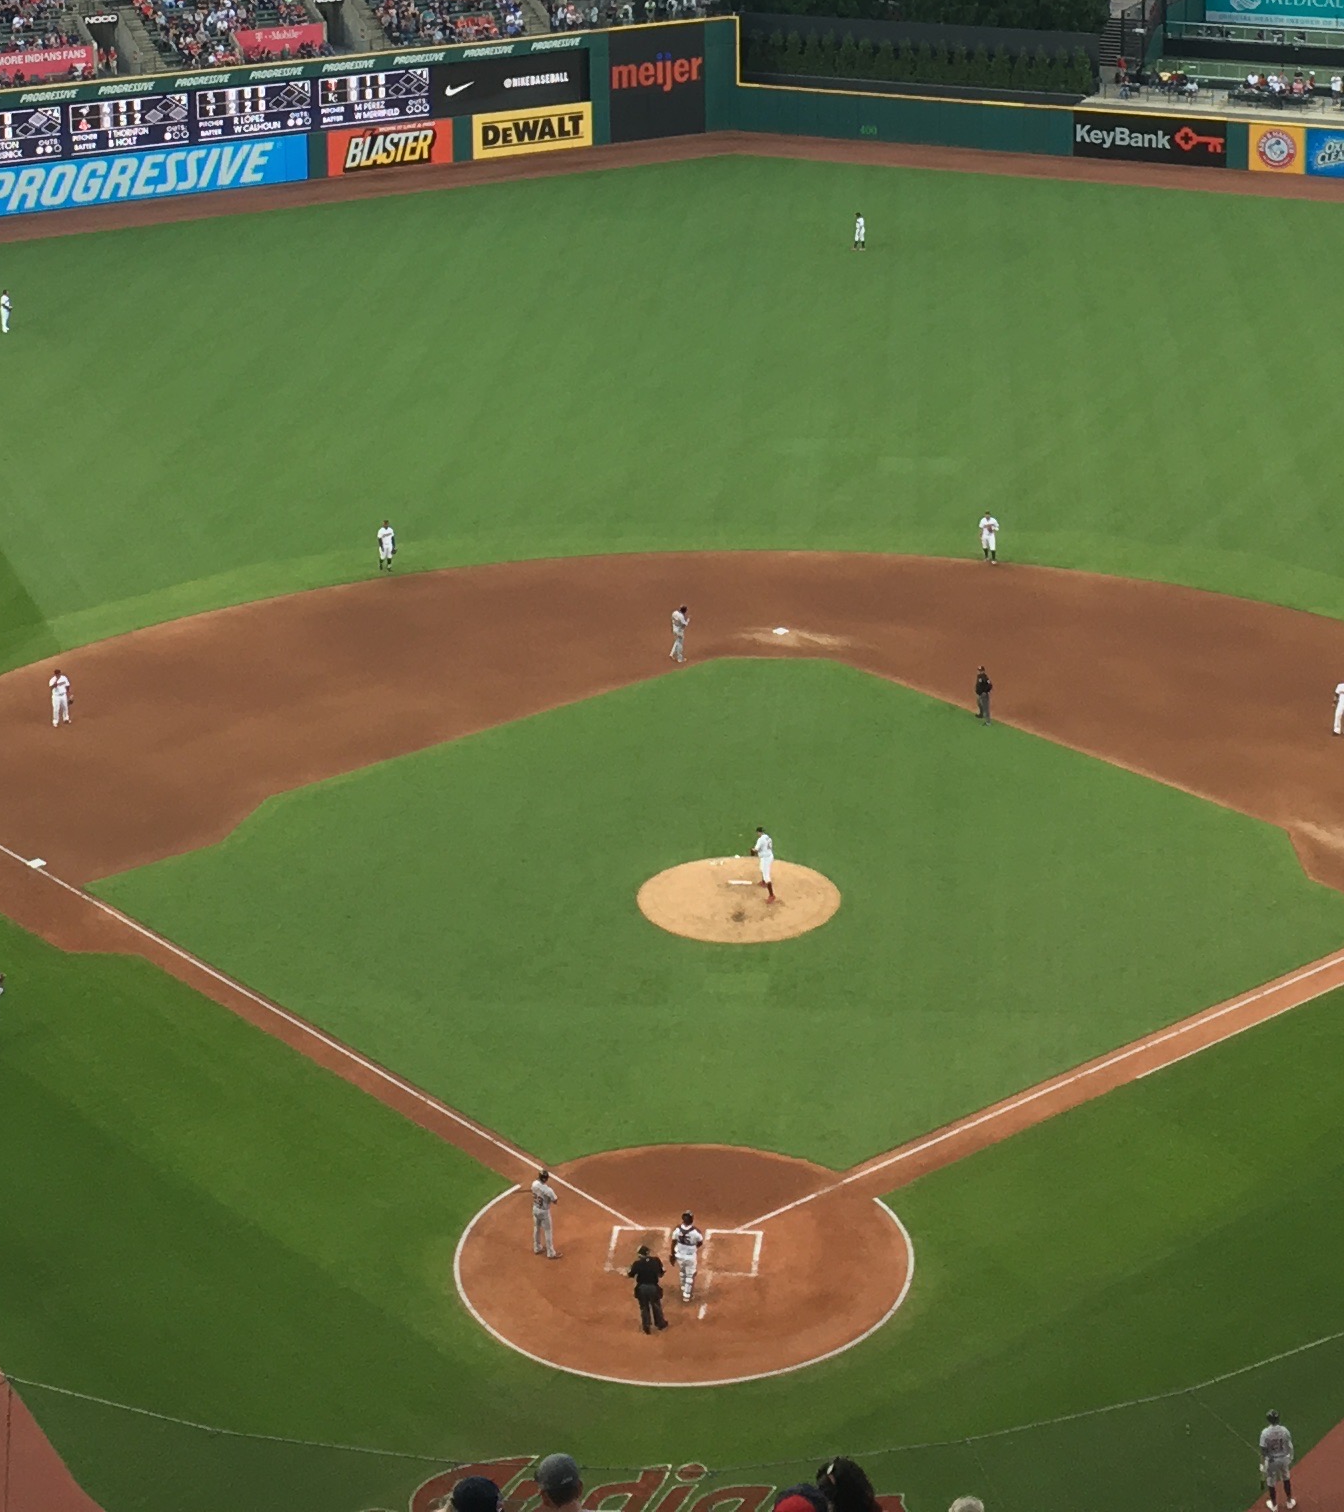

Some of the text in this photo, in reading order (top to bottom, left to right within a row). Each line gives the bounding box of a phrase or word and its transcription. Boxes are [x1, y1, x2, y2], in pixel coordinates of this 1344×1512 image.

[84, 14, 119, 24] NOCO
[462, 44, 515, 59] PROGRESSIVE
[531, 37, 582, 51] PROGRESSIVE
[24, 51, 60, 64] INDIANS
[61, 47, 86, 60] FANS
[393, 51, 445, 66] PROGRESSIVE
[322, 58, 376, 73] PROGRESSIVE
[611, 52, 701, 92] meijer
[174, 73, 231, 88] PROGRESSIVE
[249, 66, 304, 81] PROGRESSIVE
[504, 71, 569, 89] @NIKEBASEBALL
[20, 89, 79, 104] PROGRESSIVE
[97, 81, 156, 97] PROGRESSIVE
[1075, 123, 1171, 152] KeyBank
[345, 129, 435, 169] BLASTER
